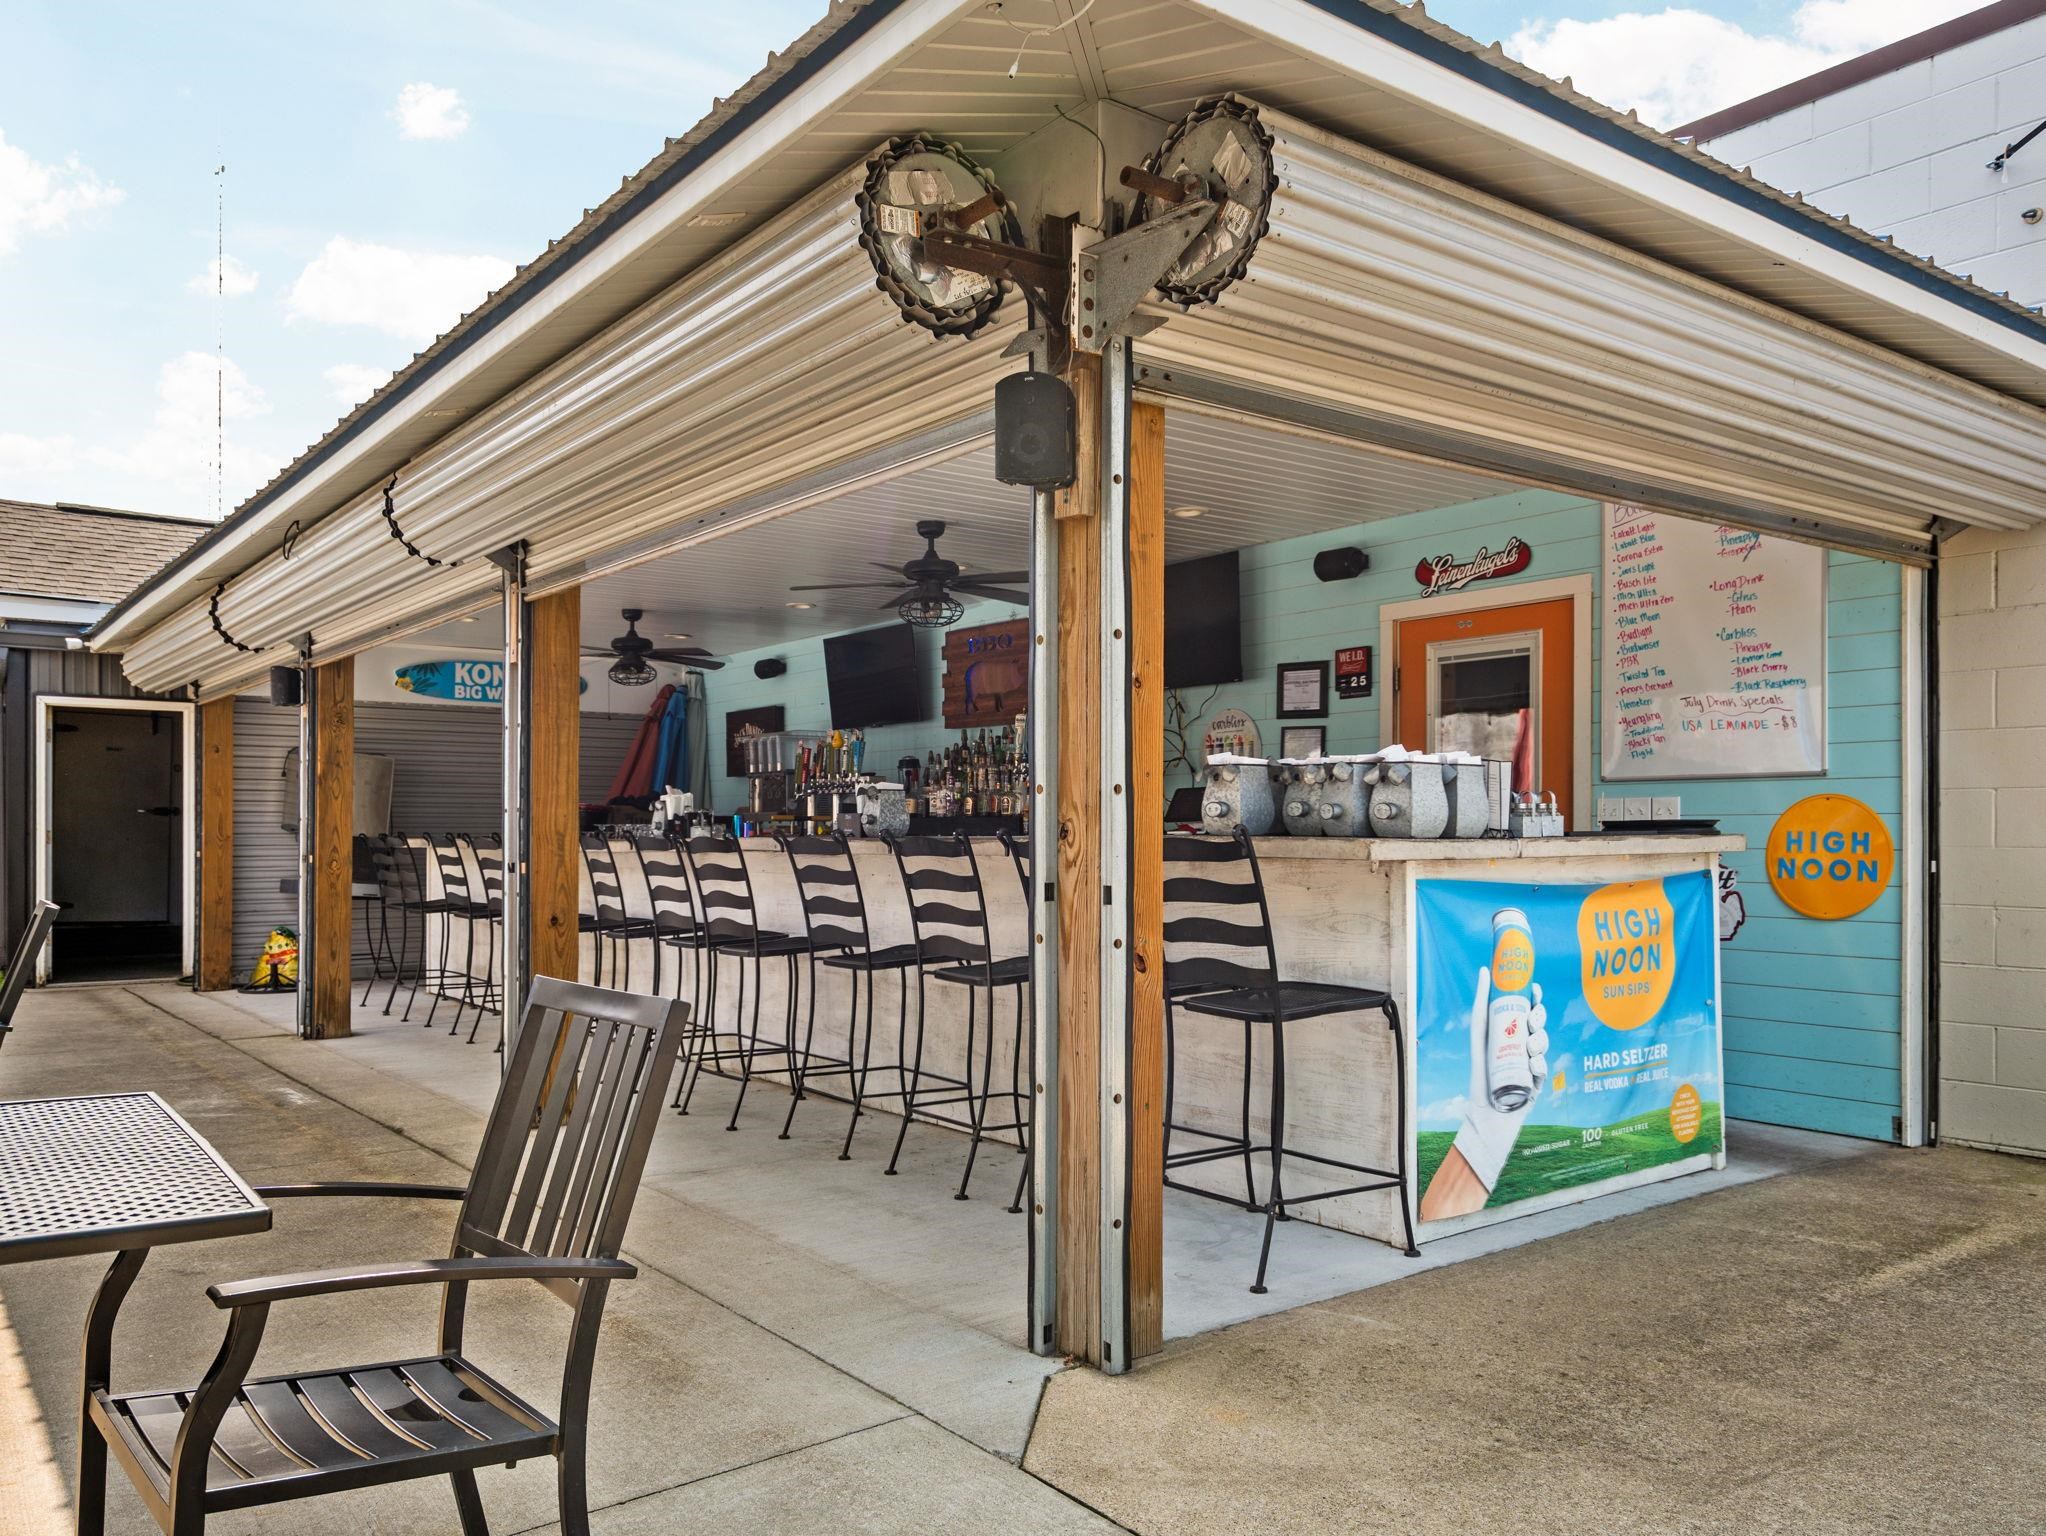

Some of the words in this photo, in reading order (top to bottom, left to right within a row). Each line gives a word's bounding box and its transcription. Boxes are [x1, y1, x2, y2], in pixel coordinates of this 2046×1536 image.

[1640, 534, 1656, 544] Blue
[1616, 551, 1643, 563] Corona
[1644, 545, 1664, 557] Extra
[1617, 578, 1641, 591] Busch
[1713, 580, 1738, 593] Long
[1736, 573, 1764, 588] Drink
[1618, 616, 1638, 629] Blue
[1720, 627, 1758, 641] Carbliss
[967, 633, 1014, 654] BBQ
[1736, 654, 1765, 665] Lemon
[454, 662, 504, 687] KON
[1619, 668, 1649, 682] Twisted
[1651, 665, 1666, 676] Tea
[1734, 664, 1760, 677] Black
[1350, 675, 1367, 687] 25
[454, 684, 482, 699] BIG
[1680, 695, 1705, 713] July
[1706, 695, 1737, 708] Drink
[1740, 694, 1784, 709] Specials
[1682, 720, 1703, 732] USA
[1710, 719, 1769, 731] LEMONADE
[1630, 747, 1655, 760] Flight
[1785, 830, 1871, 854] HIGH
[1777, 857, 1879, 883] NOON
[1594, 906, 1661, 942] HIGH
[1501, 946, 1529, 961] HIGH
[1592, 943, 1661, 978] NOON
[1498, 960, 1529, 973] NOON
[1603, 984, 1625, 999] SUN
[1627, 980, 1650, 997] SIPS
[1583, 1051, 1620, 1072] HARD
[1621, 1042, 1668, 1067] SELTZER
[1584, 1077, 1603, 1094] REAL
[1603, 1075, 1630, 1090] VODKA
[1636, 1069, 1652, 1084] REAL
[1634, 1122, 1649, 1131] FREE
[1581, 1127, 1603, 1143] 100
